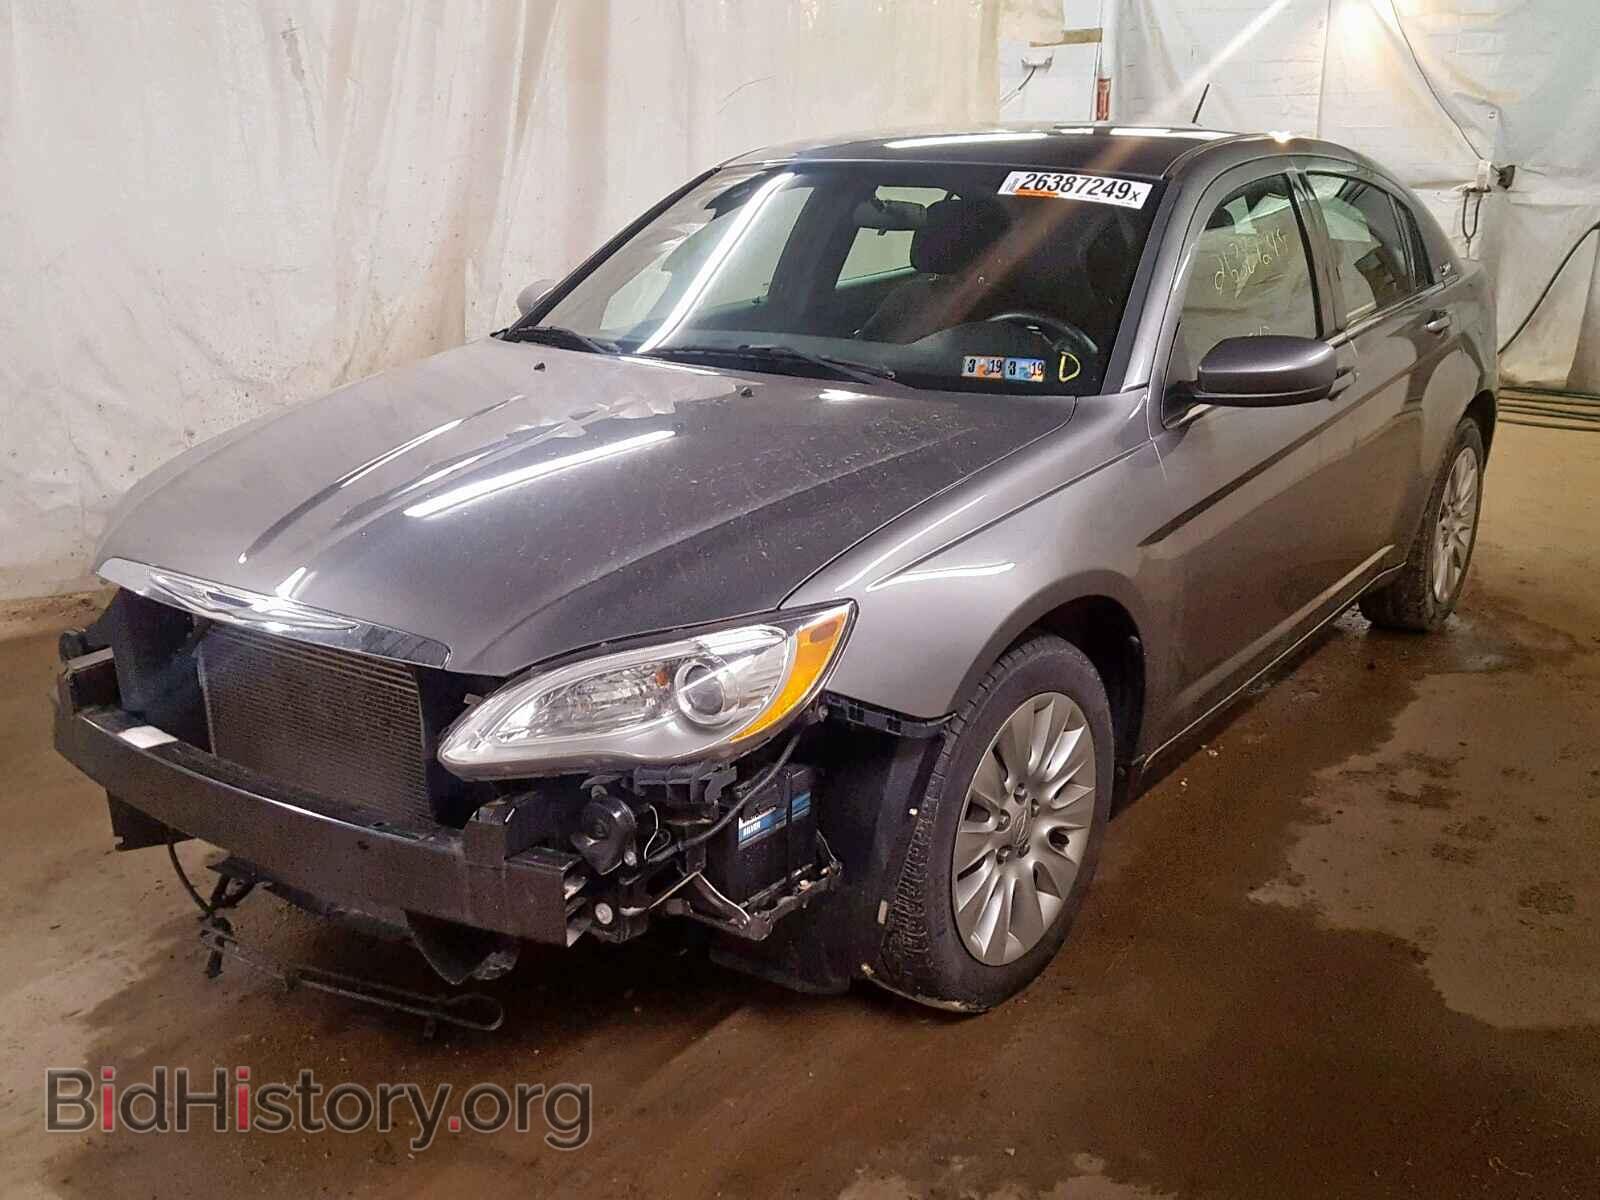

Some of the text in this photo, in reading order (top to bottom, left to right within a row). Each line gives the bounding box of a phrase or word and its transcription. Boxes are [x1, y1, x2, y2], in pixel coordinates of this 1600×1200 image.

[1019, 173, 1132, 200] 26387249
[967, 358, 1002, 374] 3 19
[1031, 361, 1043, 376] 19
[1058, 351, 1081, 382] D
